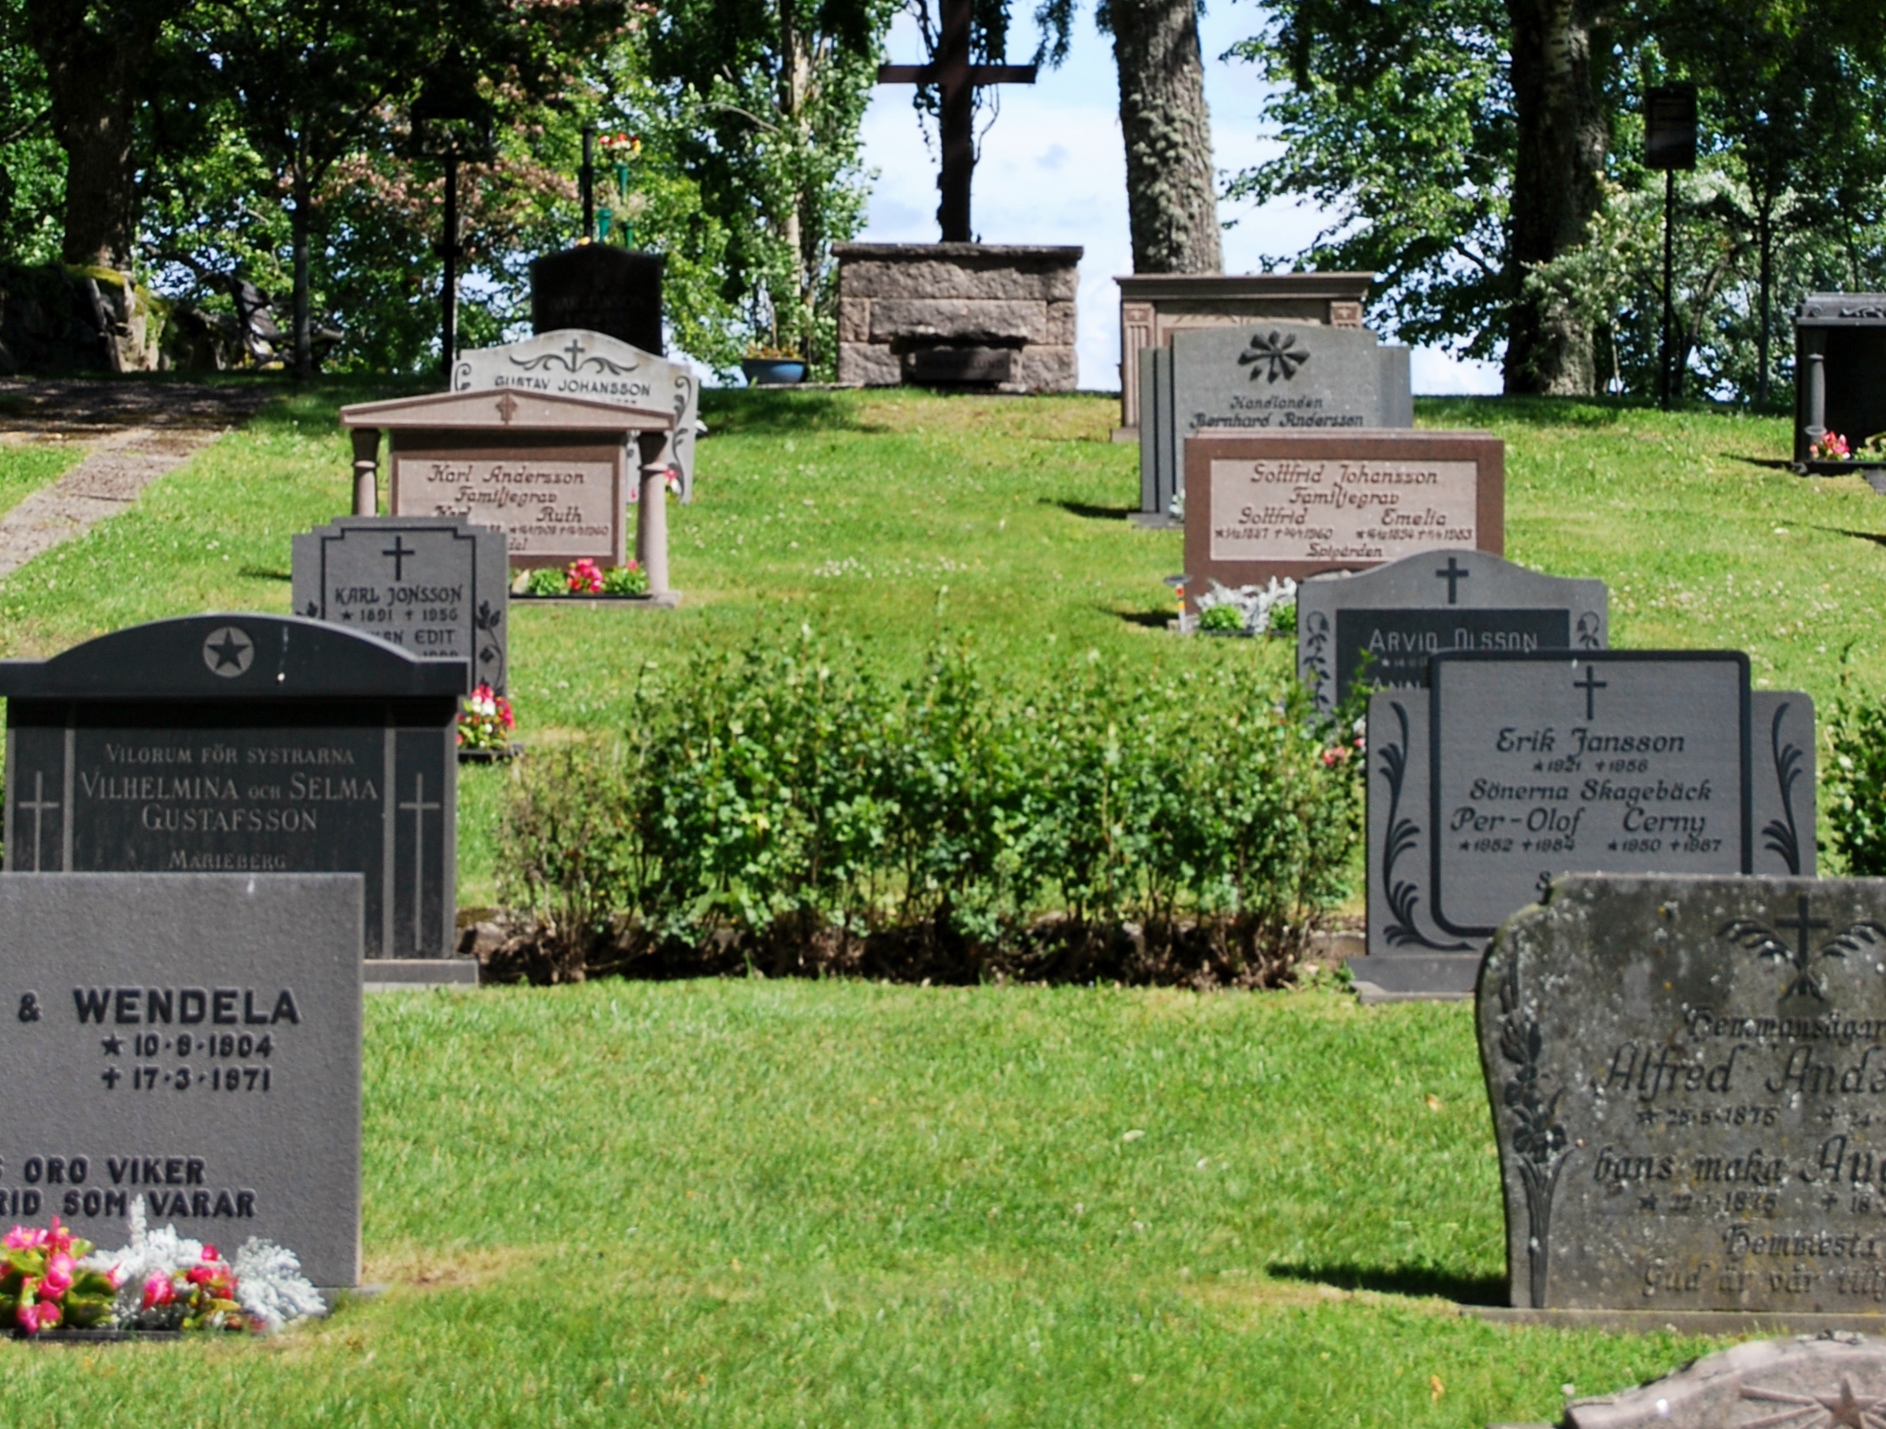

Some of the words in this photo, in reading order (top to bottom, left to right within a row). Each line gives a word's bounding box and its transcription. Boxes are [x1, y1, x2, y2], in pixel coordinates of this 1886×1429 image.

[558, 380, 650, 396] JOHANSSON
[1190, 411, 1273, 428] Bernhard
[1279, 412, 1364, 427] Andersson
[428, 465, 472, 482] Karl
[483, 466, 584, 484] Andersson
[1251, 463, 1325, 483] Gottfrid
[1339, 464, 1438, 484] Johansson
[455, 486, 557, 507] Familjegrav
[1289, 482, 1400, 509] Familjegrav
[536, 507, 582, 522] Ruth
[1239, 507, 1308, 525] Gottfrid
[1382, 508, 1446, 525] Emelia
[335, 587, 380, 605] KARL
[361, 609, 392, 622] 1891
[415, 629, 455, 644] EDIT
[1497, 728, 1555, 752] Erik
[1571, 728, 1685, 759] Jansson
[1470, 778, 1569, 801] Sönerna
[1581, 778, 1712, 807] Skagebäck
[1622, 809, 1706, 840] Cerny
[19, 991, 41, 1022] &
[73, 988, 300, 1024] WENDELA
[1590, 1041, 1747, 1102] Alfred
[24, 1157, 88, 1184] ORO
[107, 1157, 206, 1184] VIKER
[64, 1190, 128, 1218] SOM
[149, 1189, 256, 1218] VARAR
